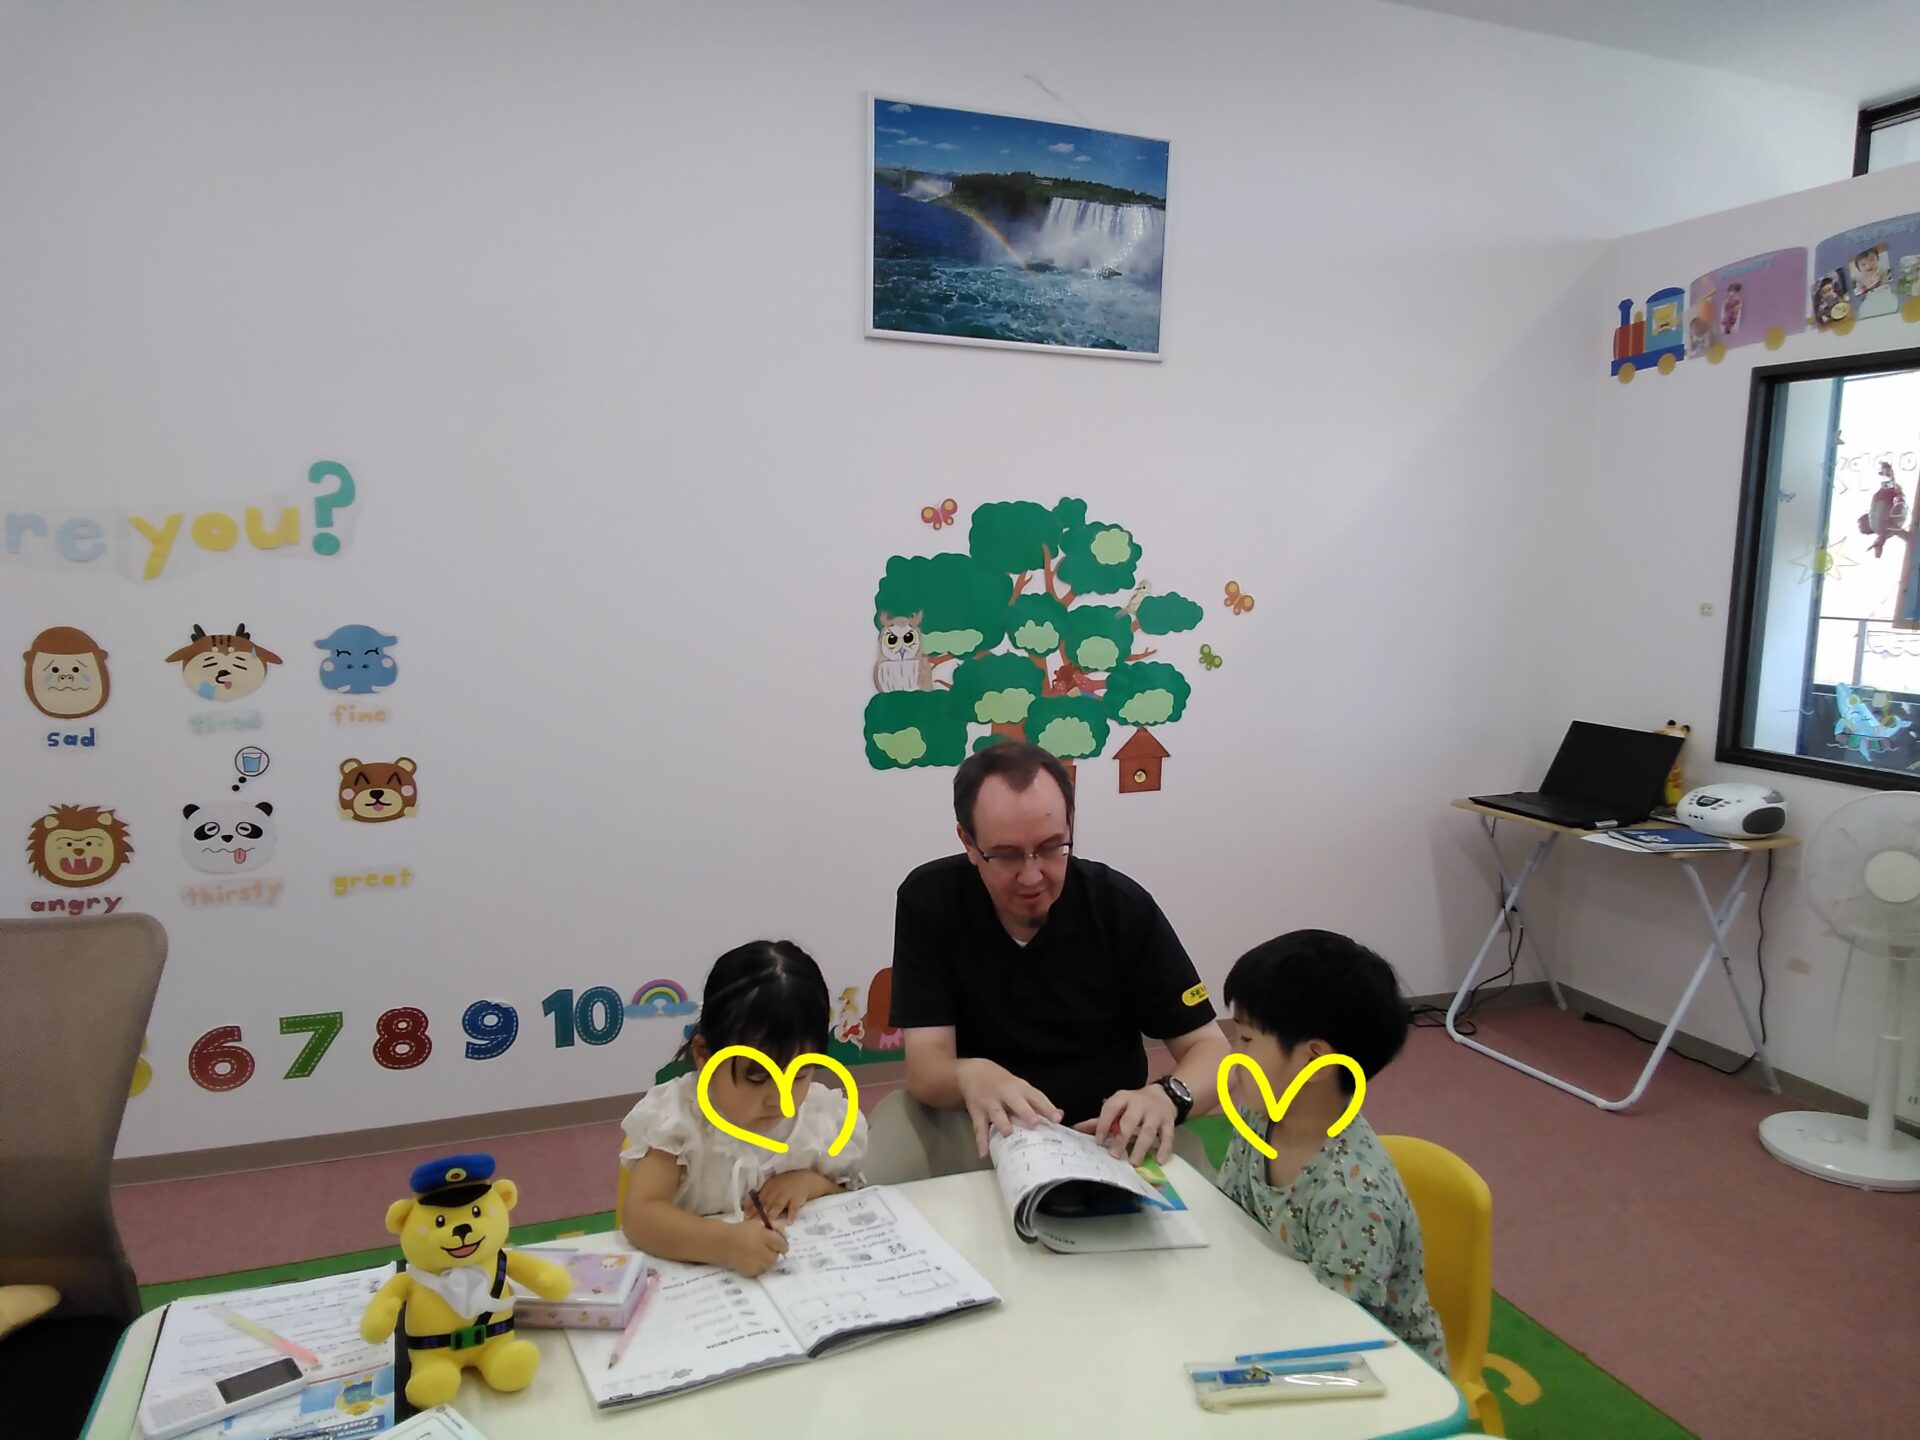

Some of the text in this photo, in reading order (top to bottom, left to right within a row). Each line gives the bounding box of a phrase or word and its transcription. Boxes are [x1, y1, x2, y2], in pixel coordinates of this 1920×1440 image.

[4, 460, 356, 581] re you?
[333, 703, 388, 725] fine
[46, 727, 97, 748] sad
[184, 879, 281, 906] thirsty
[332, 867, 413, 896] great
[30, 896, 123, 916] angry
[188, 1025, 256, 1093] 6
[279, 1010, 344, 1080] 7
[372, 1006, 434, 1071] 8
[461, 999, 519, 1061] 9
[541, 985, 625, 1049] 10
